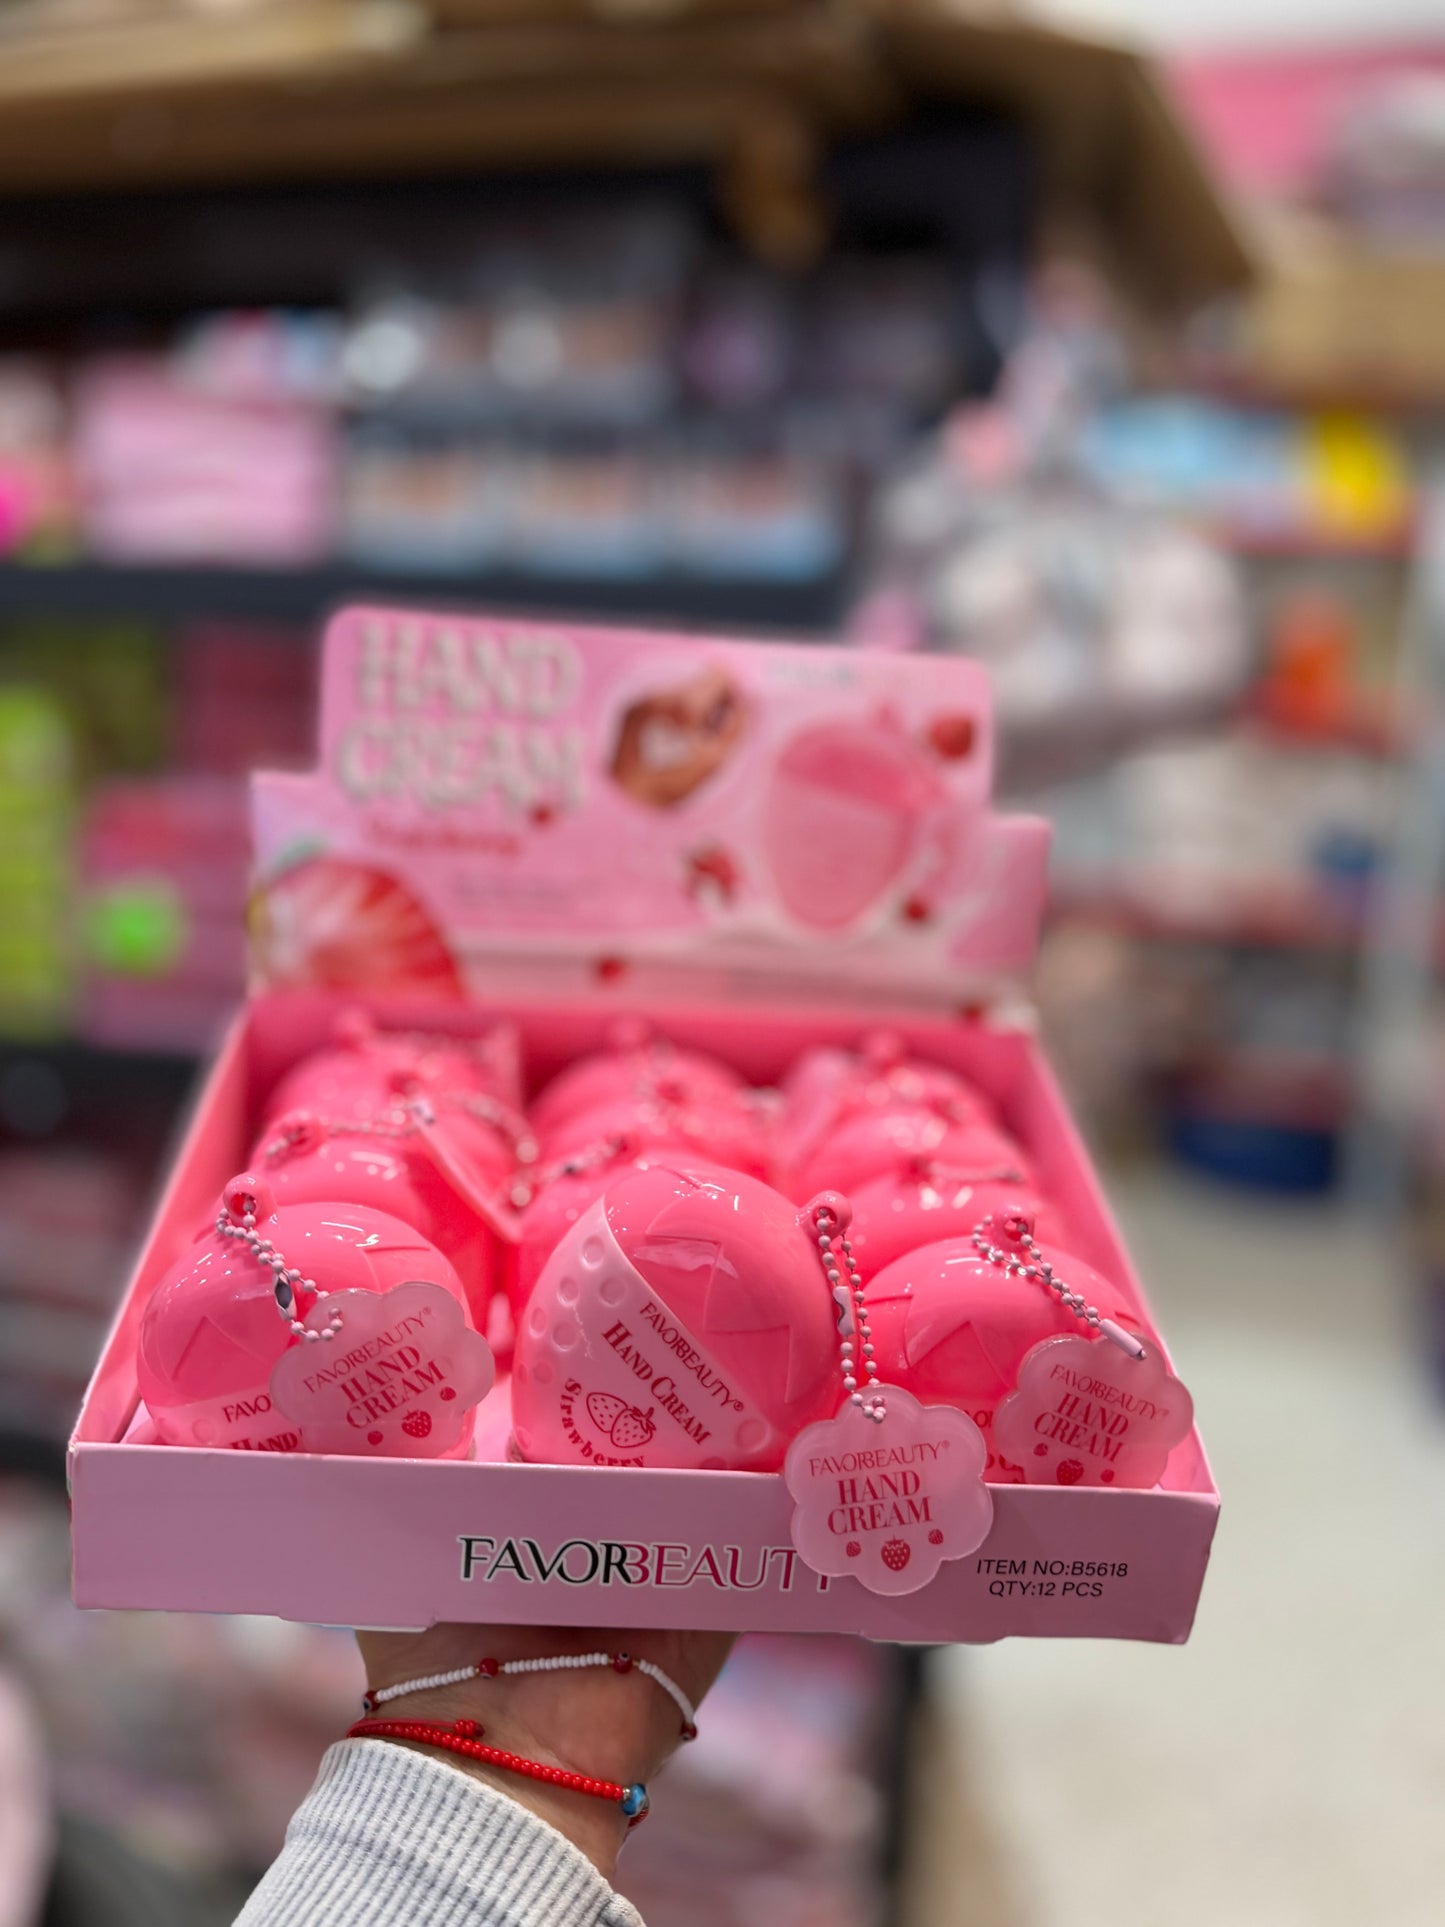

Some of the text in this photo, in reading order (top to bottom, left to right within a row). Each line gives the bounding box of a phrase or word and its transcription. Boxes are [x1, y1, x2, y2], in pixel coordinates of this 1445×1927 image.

[356, 616, 585, 720] HAND
[334, 716, 590, 818] CREAM
[340, 1345, 421, 1405] HAND
[346, 1360, 447, 1430] CREAM
[601, 1320, 712, 1445] HAND CREAM
[1033, 1411, 1124, 1463] CREAM
[1055, 1392, 1129, 1437] HAND
[828, 1496, 933, 1535] CREAM
[836, 1470, 920, 1506] HAND
[458, 1534, 831, 1592] FAVORBEAUT
[976, 1559, 1128, 1577] ITEM NO:B5618
[989, 1580, 1103, 1598] QTY:12 PCS
